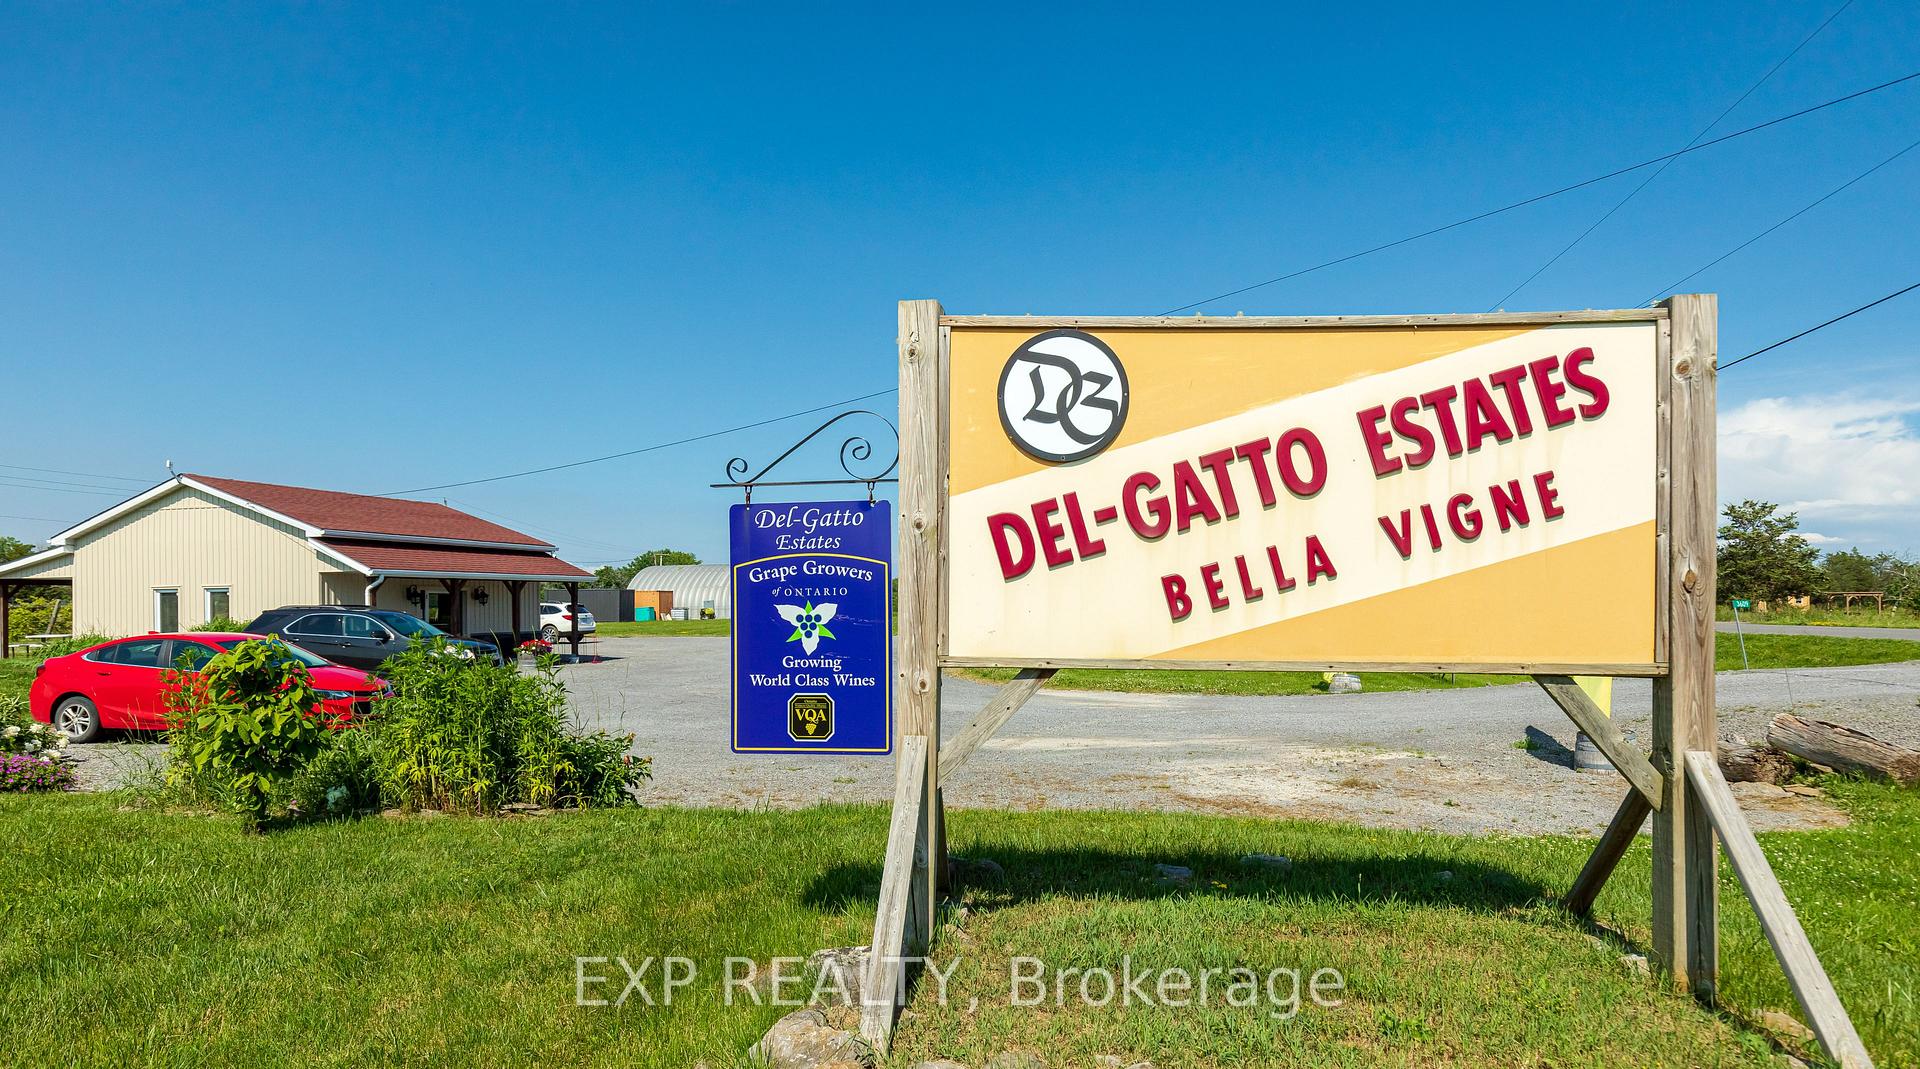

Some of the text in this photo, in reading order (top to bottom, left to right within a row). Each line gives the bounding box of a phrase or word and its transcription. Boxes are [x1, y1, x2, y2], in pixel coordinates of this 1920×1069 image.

[987, 346, 1610, 583] DEL-GATTO ESTATES
[754, 506, 864, 534] Del-Gatto
[775, 534, 841, 550] Estates
[1161, 470, 1565, 623] BELLA VIGNE
[749, 560, 873, 583] Grape Growers
[771, 586, 848, 597] of ONTARIO
[782, 655, 842, 671] Growing
[750, 674, 876, 687] World Class Wines
[795, 708, 827, 724] VQA
